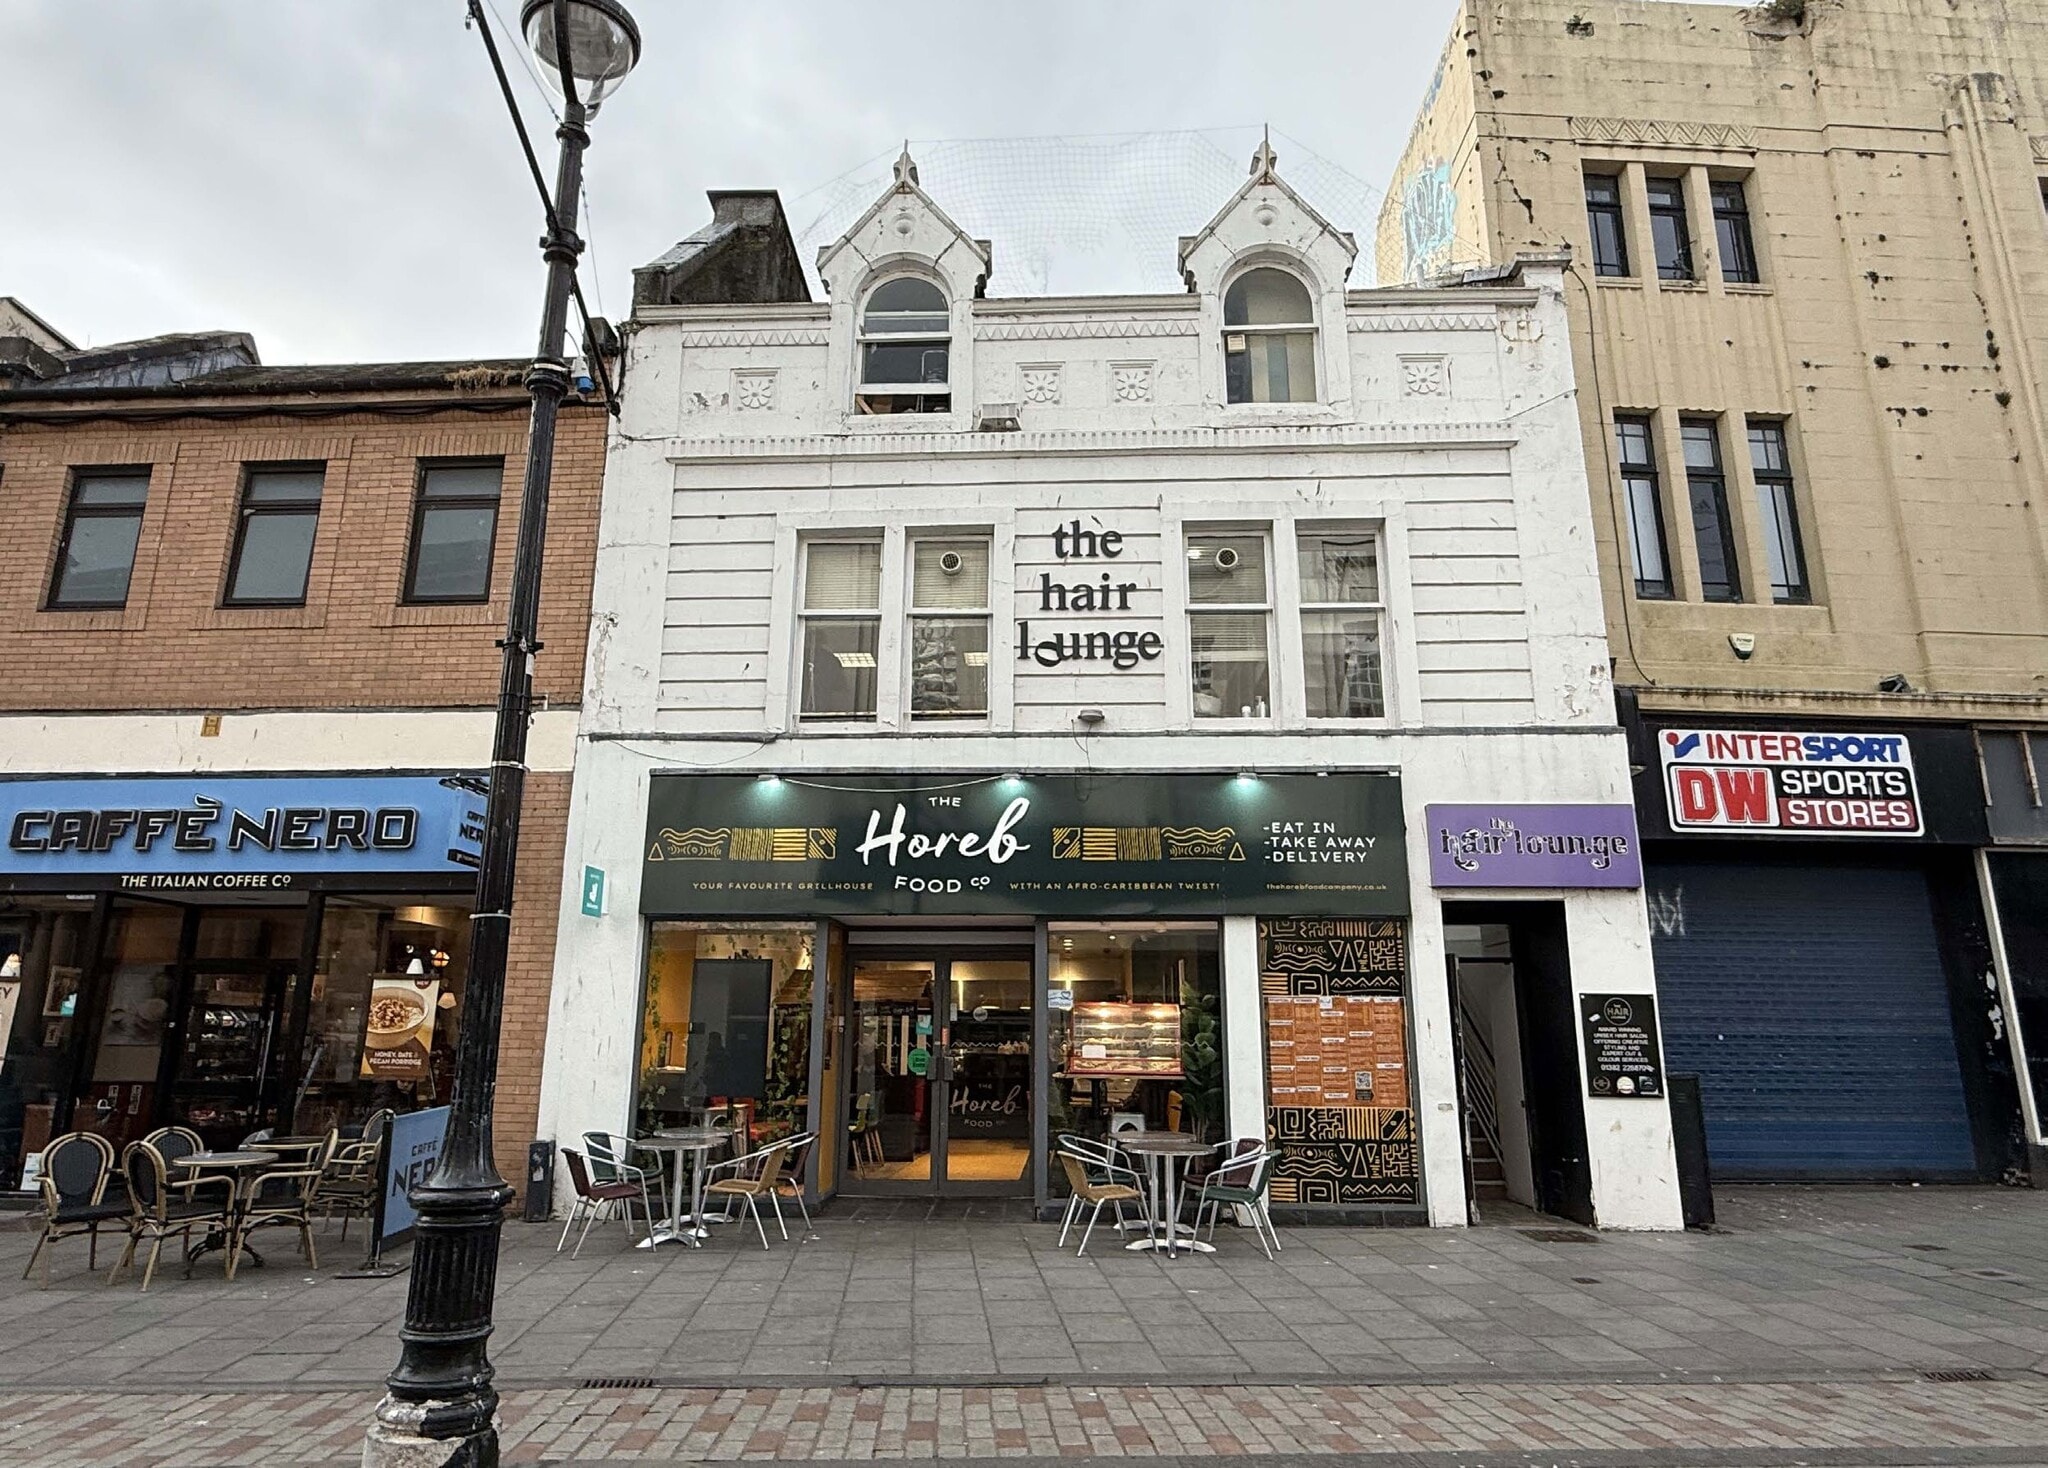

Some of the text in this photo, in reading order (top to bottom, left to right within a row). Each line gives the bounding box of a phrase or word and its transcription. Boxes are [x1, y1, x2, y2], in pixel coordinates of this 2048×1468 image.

[1052, 520, 1123, 558] the
[1039, 573, 1136, 611] hair
[1017, 621, 1161, 670] lounge
[1706, 733, 1902, 763] INTERSPORT
[1675, 767, 1770, 824] DW
[1781, 769, 1907, 796] SPORTS
[928, 796, 962, 807] THE
[1788, 800, 1910, 827] STORES
[9, 794, 419, 852] CAFFÈ NERO
[459, 822, 484, 844] NER
[855, 797, 1031, 867] Horeb
[1313, 822, 1335, 833] IN
[1326, 836, 1376, 848] AWAY
[1440, 828, 1628, 872] hair lounge
[121, 875, 147, 887] THE
[151, 875, 208, 887] ITALIAN
[213, 875, 268, 887] COFFEE
[692, 882, 873, 890] YOUR FAVOURITE GRILLHOUSE
[894, 875, 961, 893] FOOD
[1009, 882, 1220, 890] WITH AN AFRO-CARIBBEAN TWIST!
[1607, 1007, 1629, 1016] HAIR
[949, 1084, 1022, 1115] Horeb
[392, 1157, 440, 1197] NER
